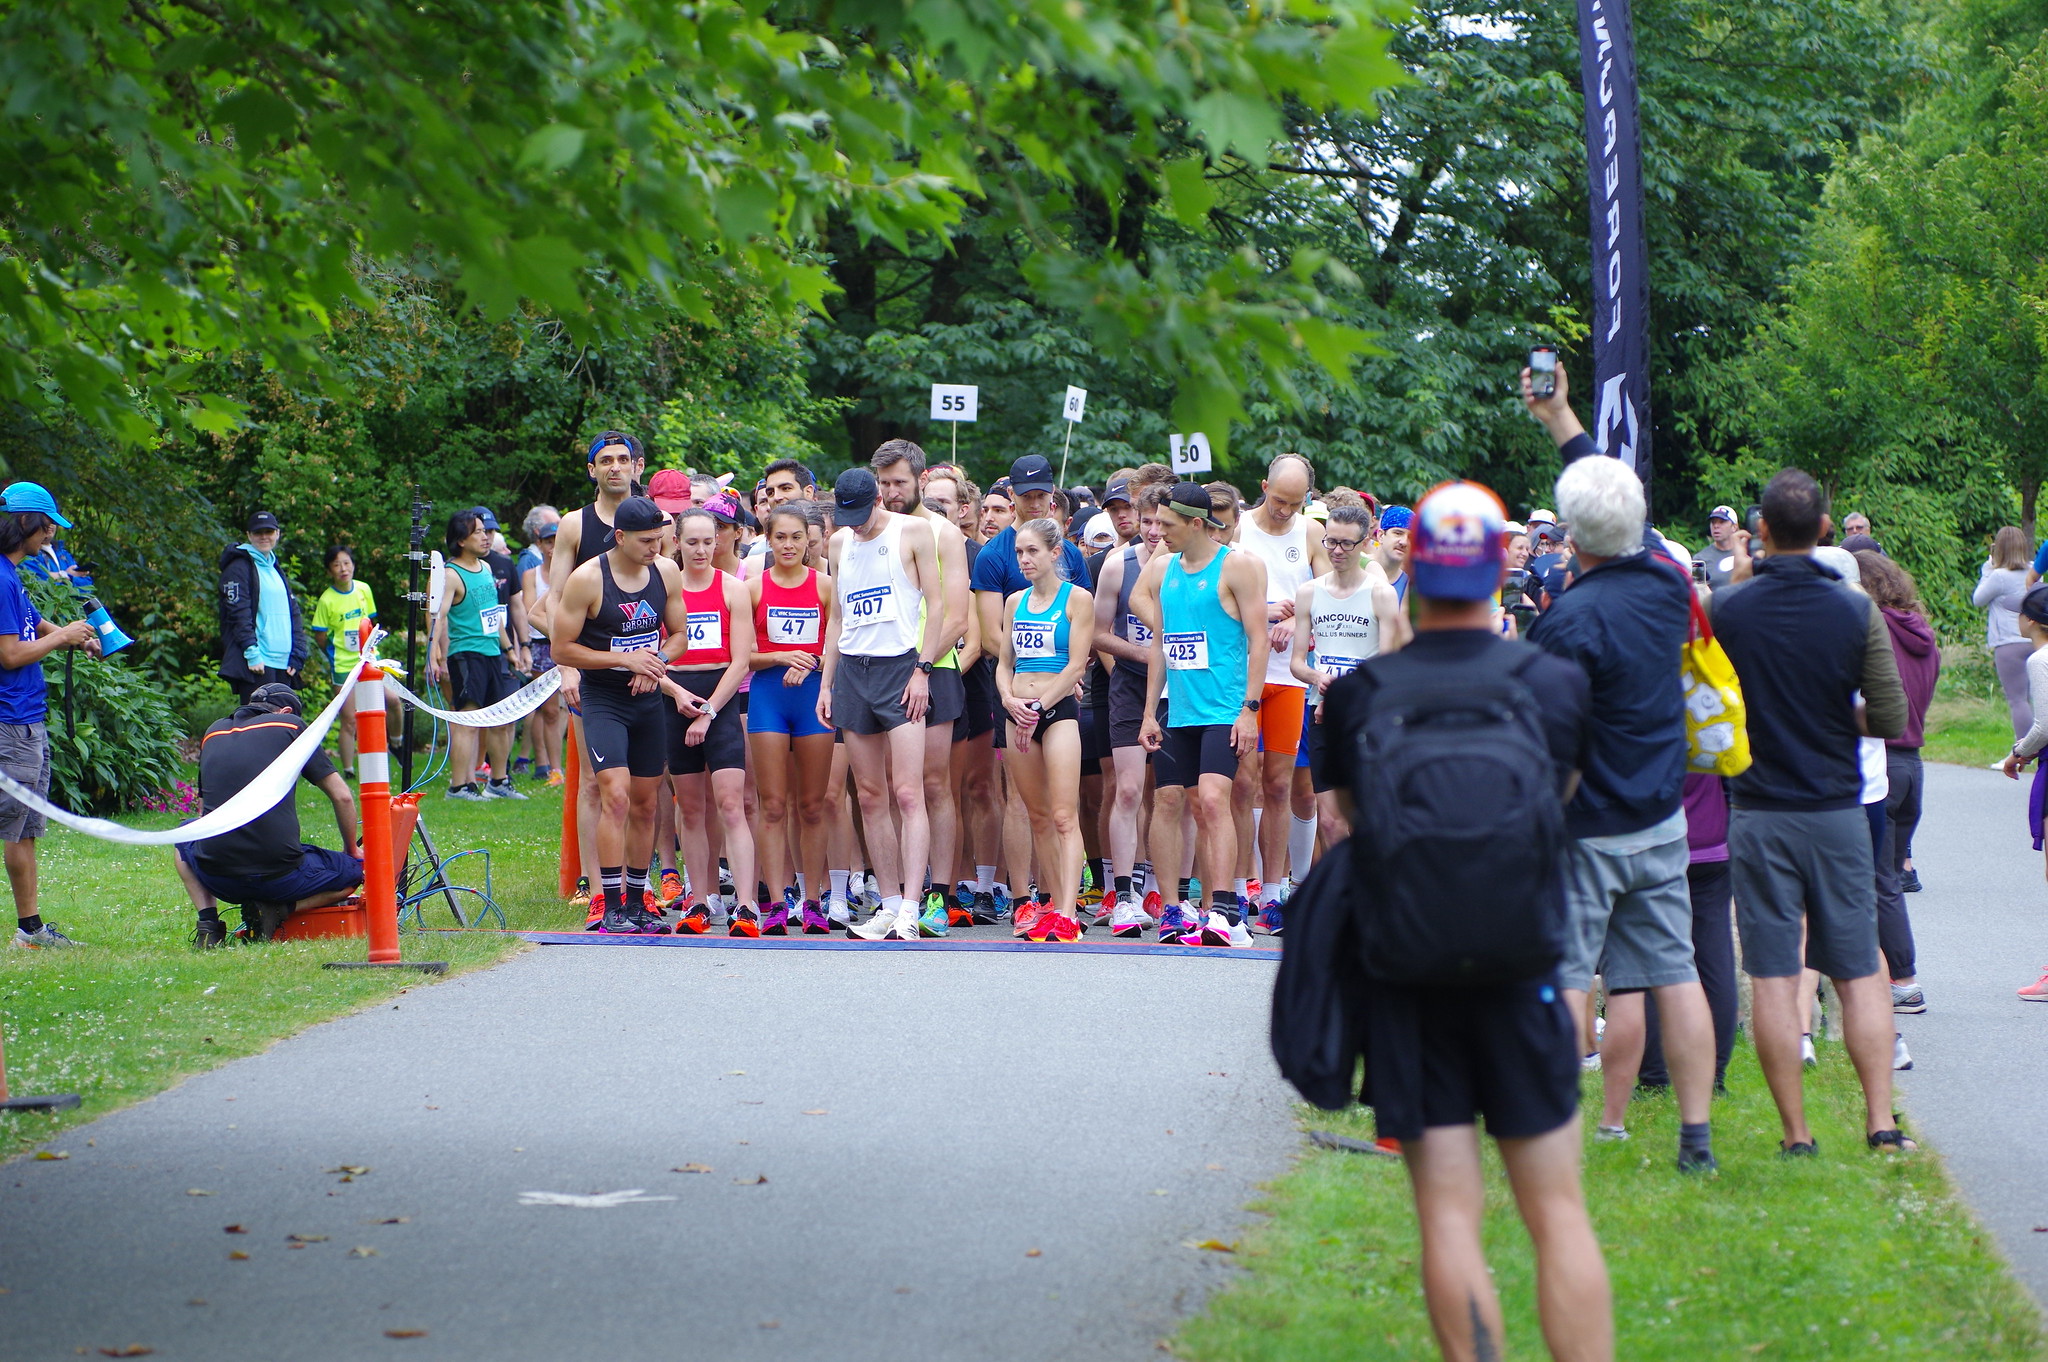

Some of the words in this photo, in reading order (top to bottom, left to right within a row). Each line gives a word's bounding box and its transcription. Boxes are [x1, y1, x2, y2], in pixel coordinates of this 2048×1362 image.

[942, 394, 966, 411] 55
[1069, 396, 1080, 413] 60
[1179, 444, 1200, 463] 50
[853, 597, 883, 617] 407
[622, 617, 657, 628] TORONTO
[782, 619, 805, 635] 47
[1313, 613, 1370, 626] VANCOUVER
[1016, 632, 1044, 648] 428
[1169, 643, 1197, 660] 423
